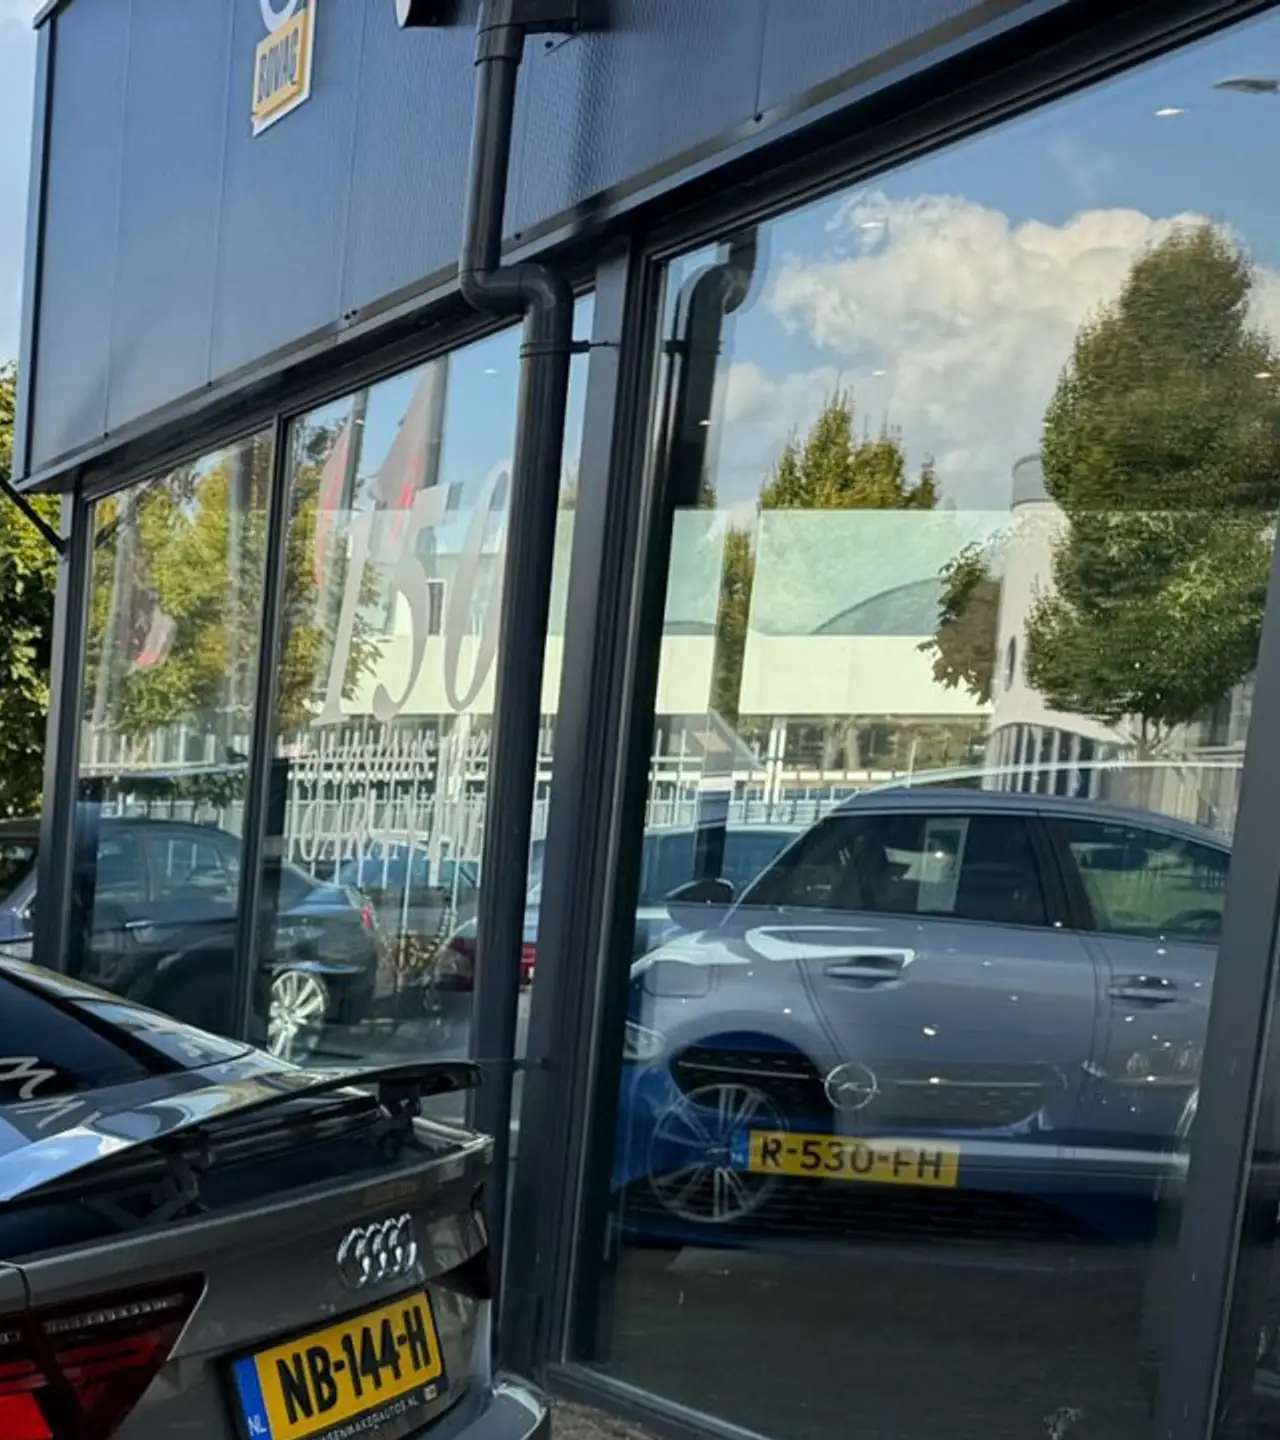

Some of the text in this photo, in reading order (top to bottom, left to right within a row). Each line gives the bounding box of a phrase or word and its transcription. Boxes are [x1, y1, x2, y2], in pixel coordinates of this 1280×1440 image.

[310, 456, 513, 726] 150
[759, 1135, 944, 1180] R-530-FH
[276, 1305, 432, 1425] NB-144-H
[247, 1415, 267, 1437] NL
